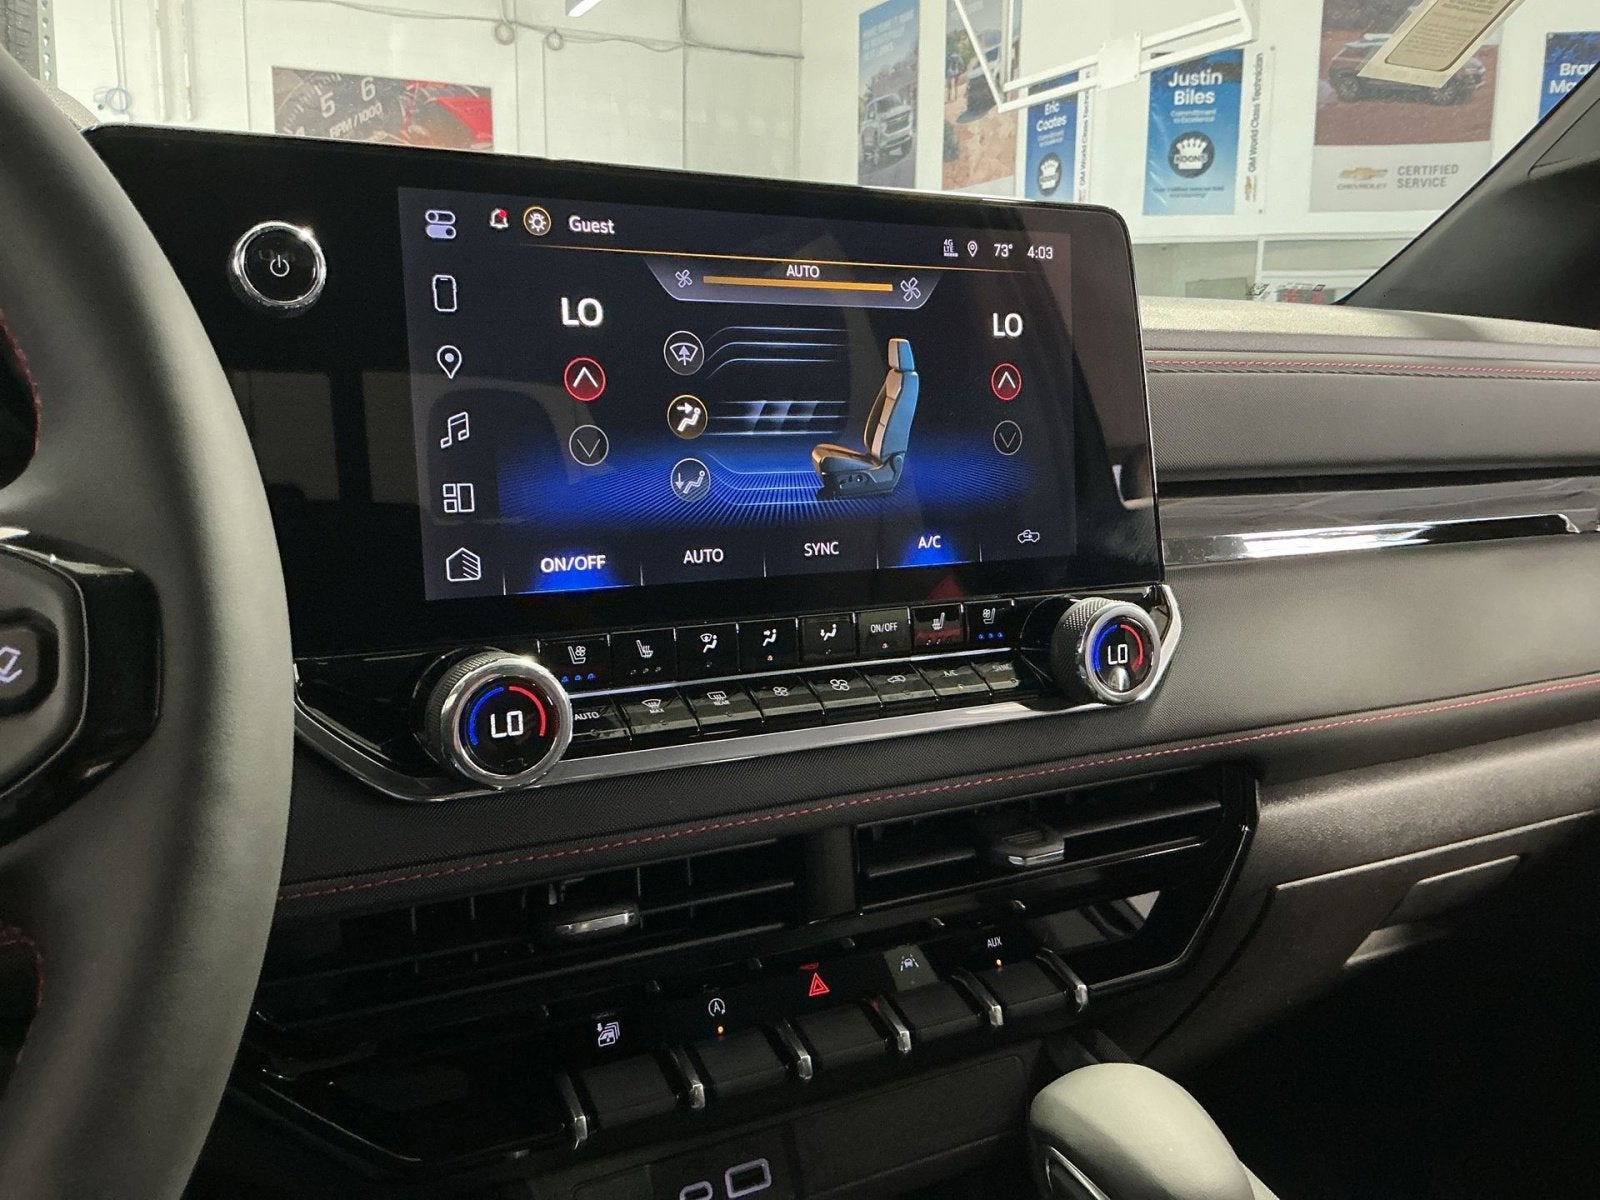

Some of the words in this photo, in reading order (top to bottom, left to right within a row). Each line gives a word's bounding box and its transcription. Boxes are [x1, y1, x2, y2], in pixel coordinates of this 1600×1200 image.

[1168, 67, 1223, 87] Justin
[1252, 52, 1264, 102] Technician
[360, 76, 376, 101] 6
[1173, 88, 1216, 106] Biles
[319, 91, 336, 118] 5
[1044, 101, 1060, 116] Eric
[1251, 104, 1261, 129] Class
[1249, 130, 1259, 156] World
[1397, 164, 1459, 176] CERTIFIED
[1396, 177, 1448, 189] SERVICE
[568, 215, 615, 234] Guest
[943, 238, 953, 246] 4G
[1027, 245, 1053, 259] 4:03
[786, 264, 820, 278] AUTO
[561, 297, 604, 327] LO
[992, 312, 1023, 337] LO
[804, 541, 839, 557] SYNC
[918, 535, 942, 549] A/C
[540, 554, 606, 573] ON/OFF
[683, 548, 724, 564] AUTO
[870, 622, 898, 633] ON/OFF
[1107, 643, 1128, 665] LO
[490, 710, 524, 739] LO
[574, 711, 600, 722] AUTO
[987, 936, 1002, 948] AUX
